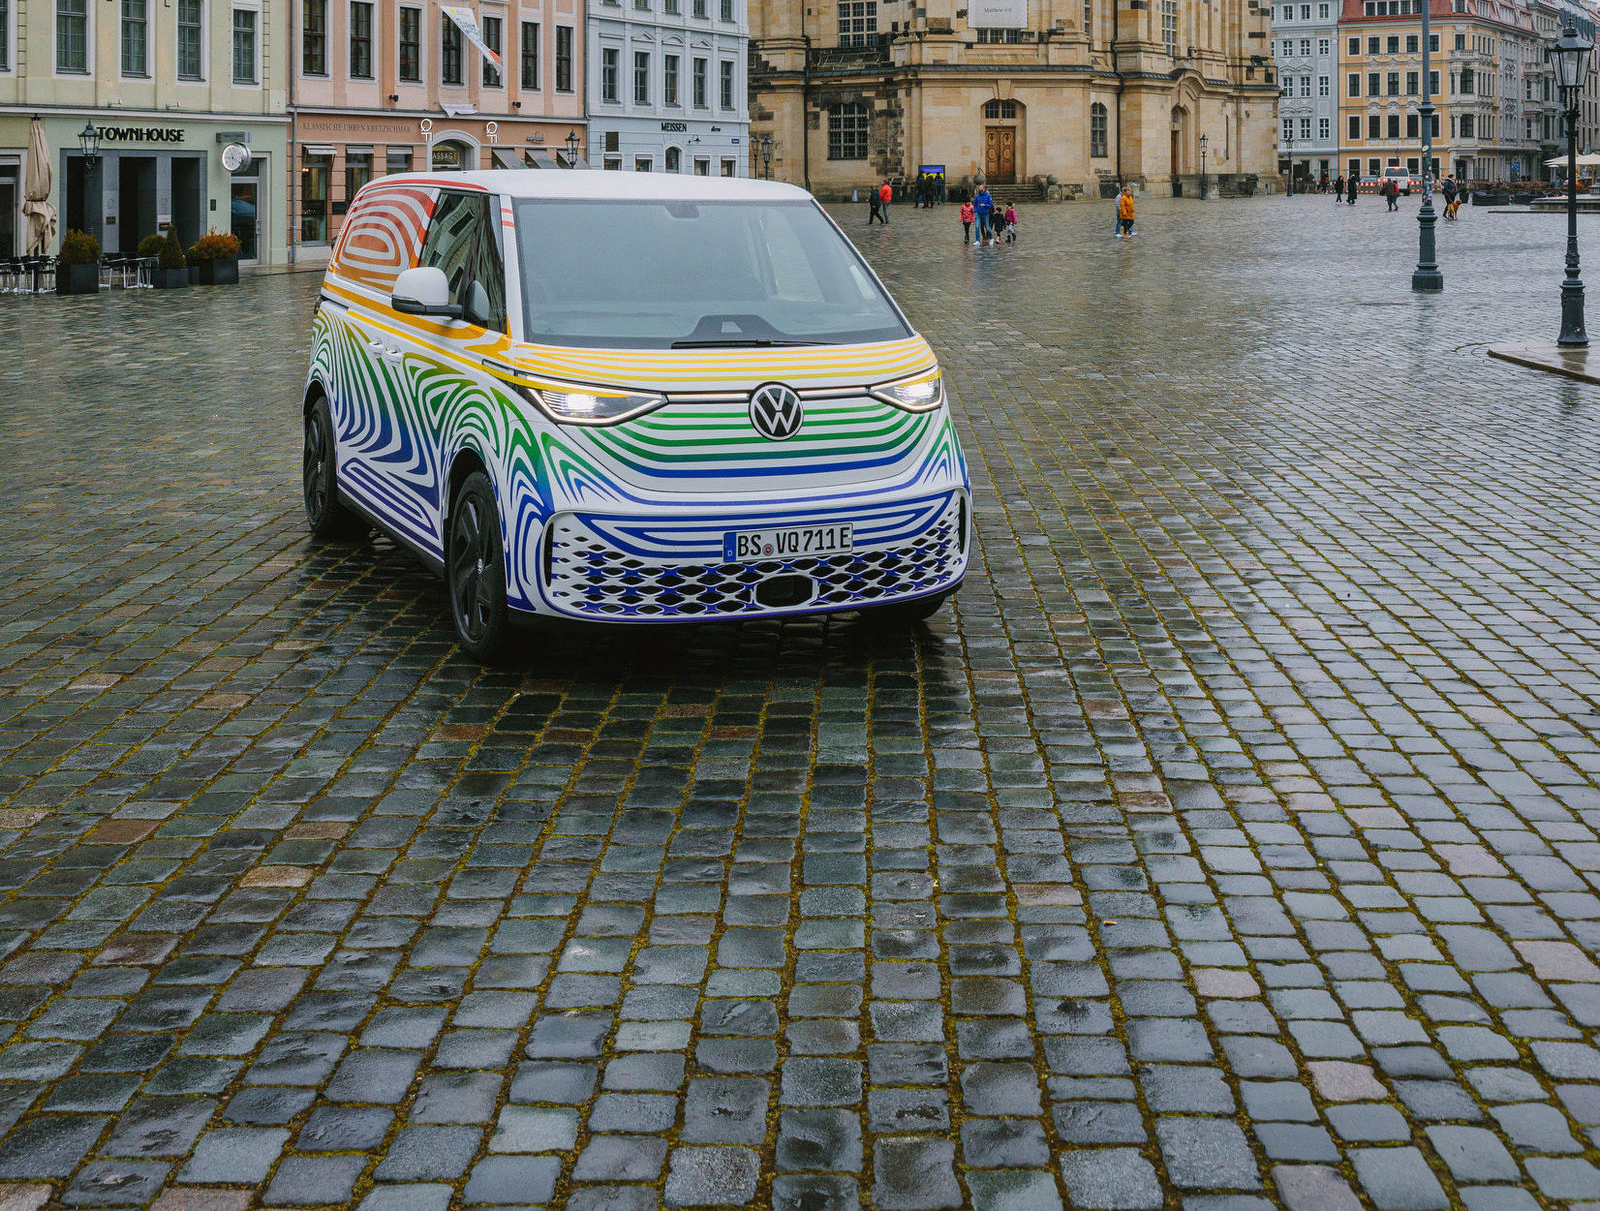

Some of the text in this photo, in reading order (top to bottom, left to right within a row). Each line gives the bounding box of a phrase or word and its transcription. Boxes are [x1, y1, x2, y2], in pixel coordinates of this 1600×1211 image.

[661, 122, 687, 132] MEISSEN
[96, 126, 185, 142] TOWNHOUSE
[432, 152, 457, 160] ASSAGE
[737, 534, 762, 558] BS
